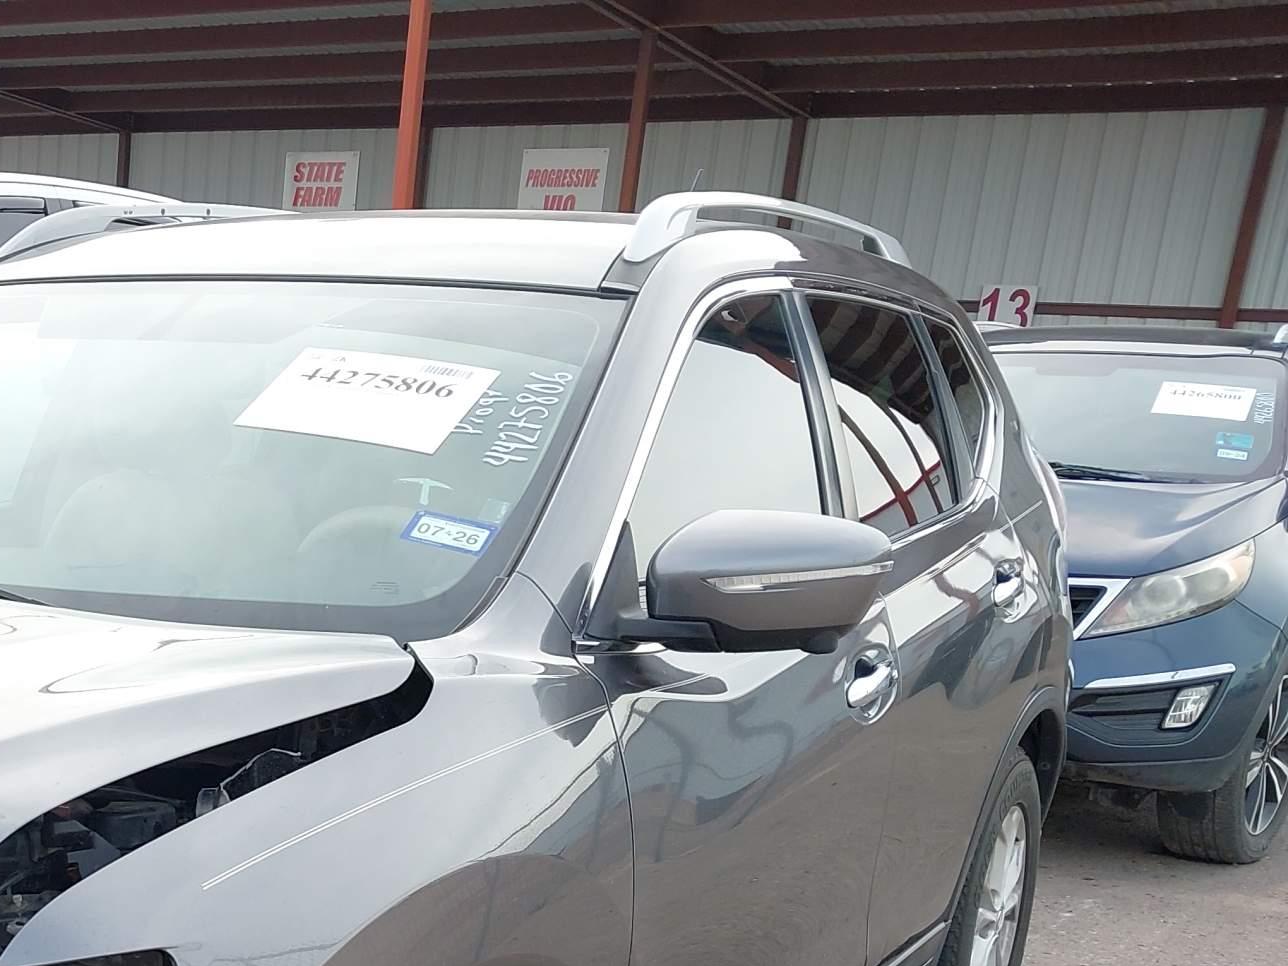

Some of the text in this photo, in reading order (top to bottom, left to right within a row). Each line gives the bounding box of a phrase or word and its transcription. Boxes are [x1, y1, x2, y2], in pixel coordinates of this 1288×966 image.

[293, 162, 346, 183] STATE
[525, 168, 600, 188] PROGRESSIVE
[292, 186, 342, 208] FARM
[981, 287, 1031, 328] 13
[300, 367, 458, 398] 44275806
[482, 371, 573, 467] 44275806
